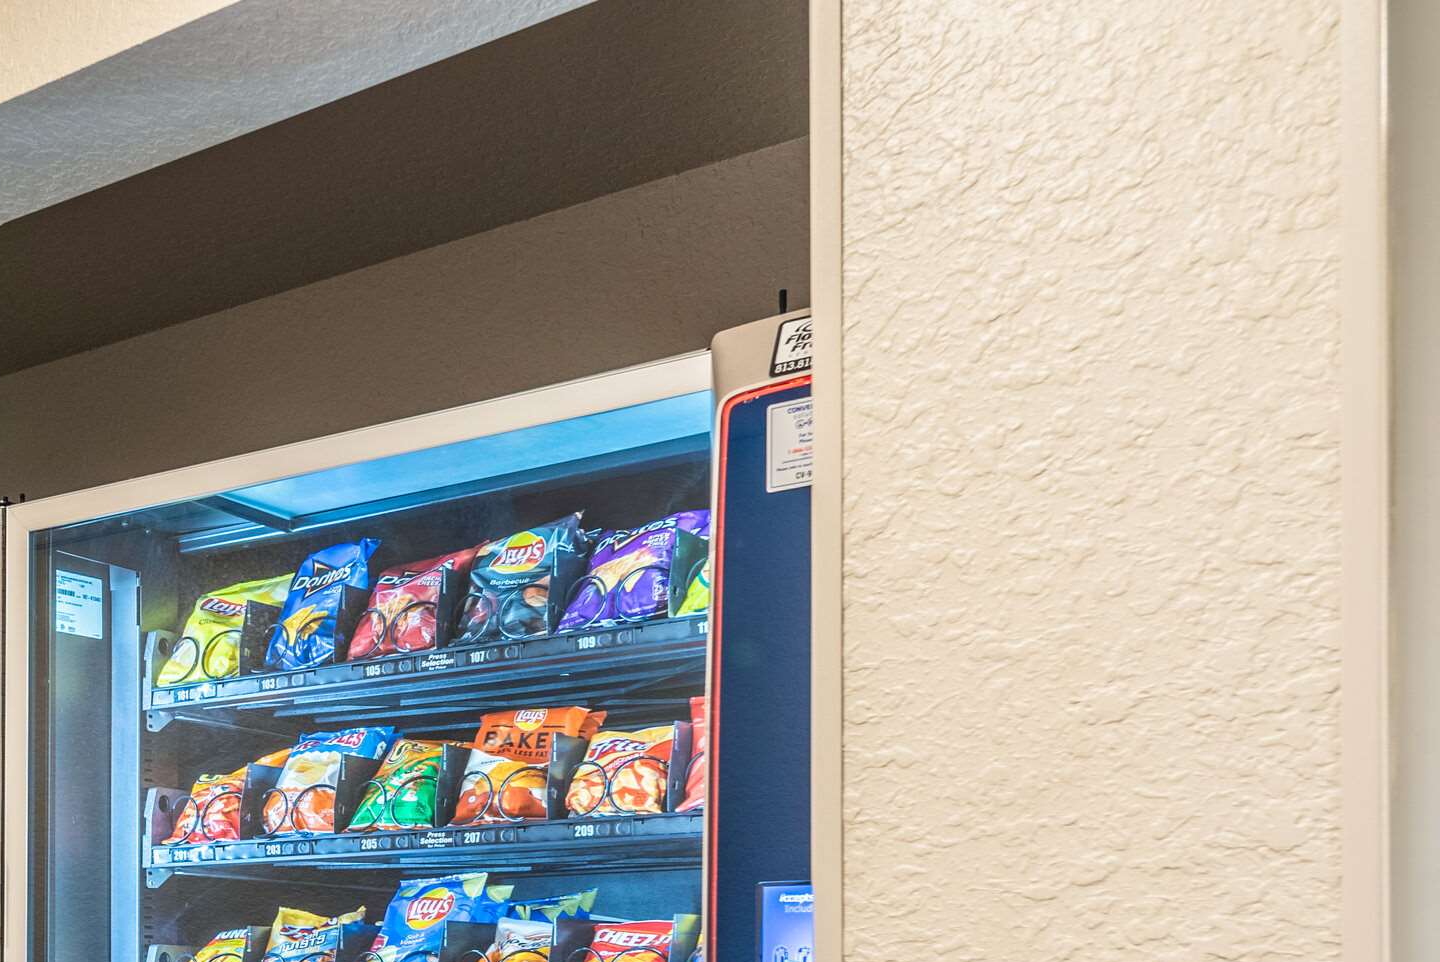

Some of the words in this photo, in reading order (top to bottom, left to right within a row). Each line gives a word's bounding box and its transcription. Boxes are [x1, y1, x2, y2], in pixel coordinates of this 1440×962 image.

[293, 562, 351, 592] Doritos
[577, 637, 596, 649] 109
[421, 658, 454, 667] Selection
[470, 651, 485, 663] 107
[365, 665, 380, 676] 105
[262, 679, 275, 690] 103
[484, 731, 550, 750] BAKE
[574, 825, 594, 837] 209
[420, 837, 453, 845] Selection
[464, 832, 480, 843] 207
[265, 844, 280, 856] 203
[361, 839, 377, 850] 205
